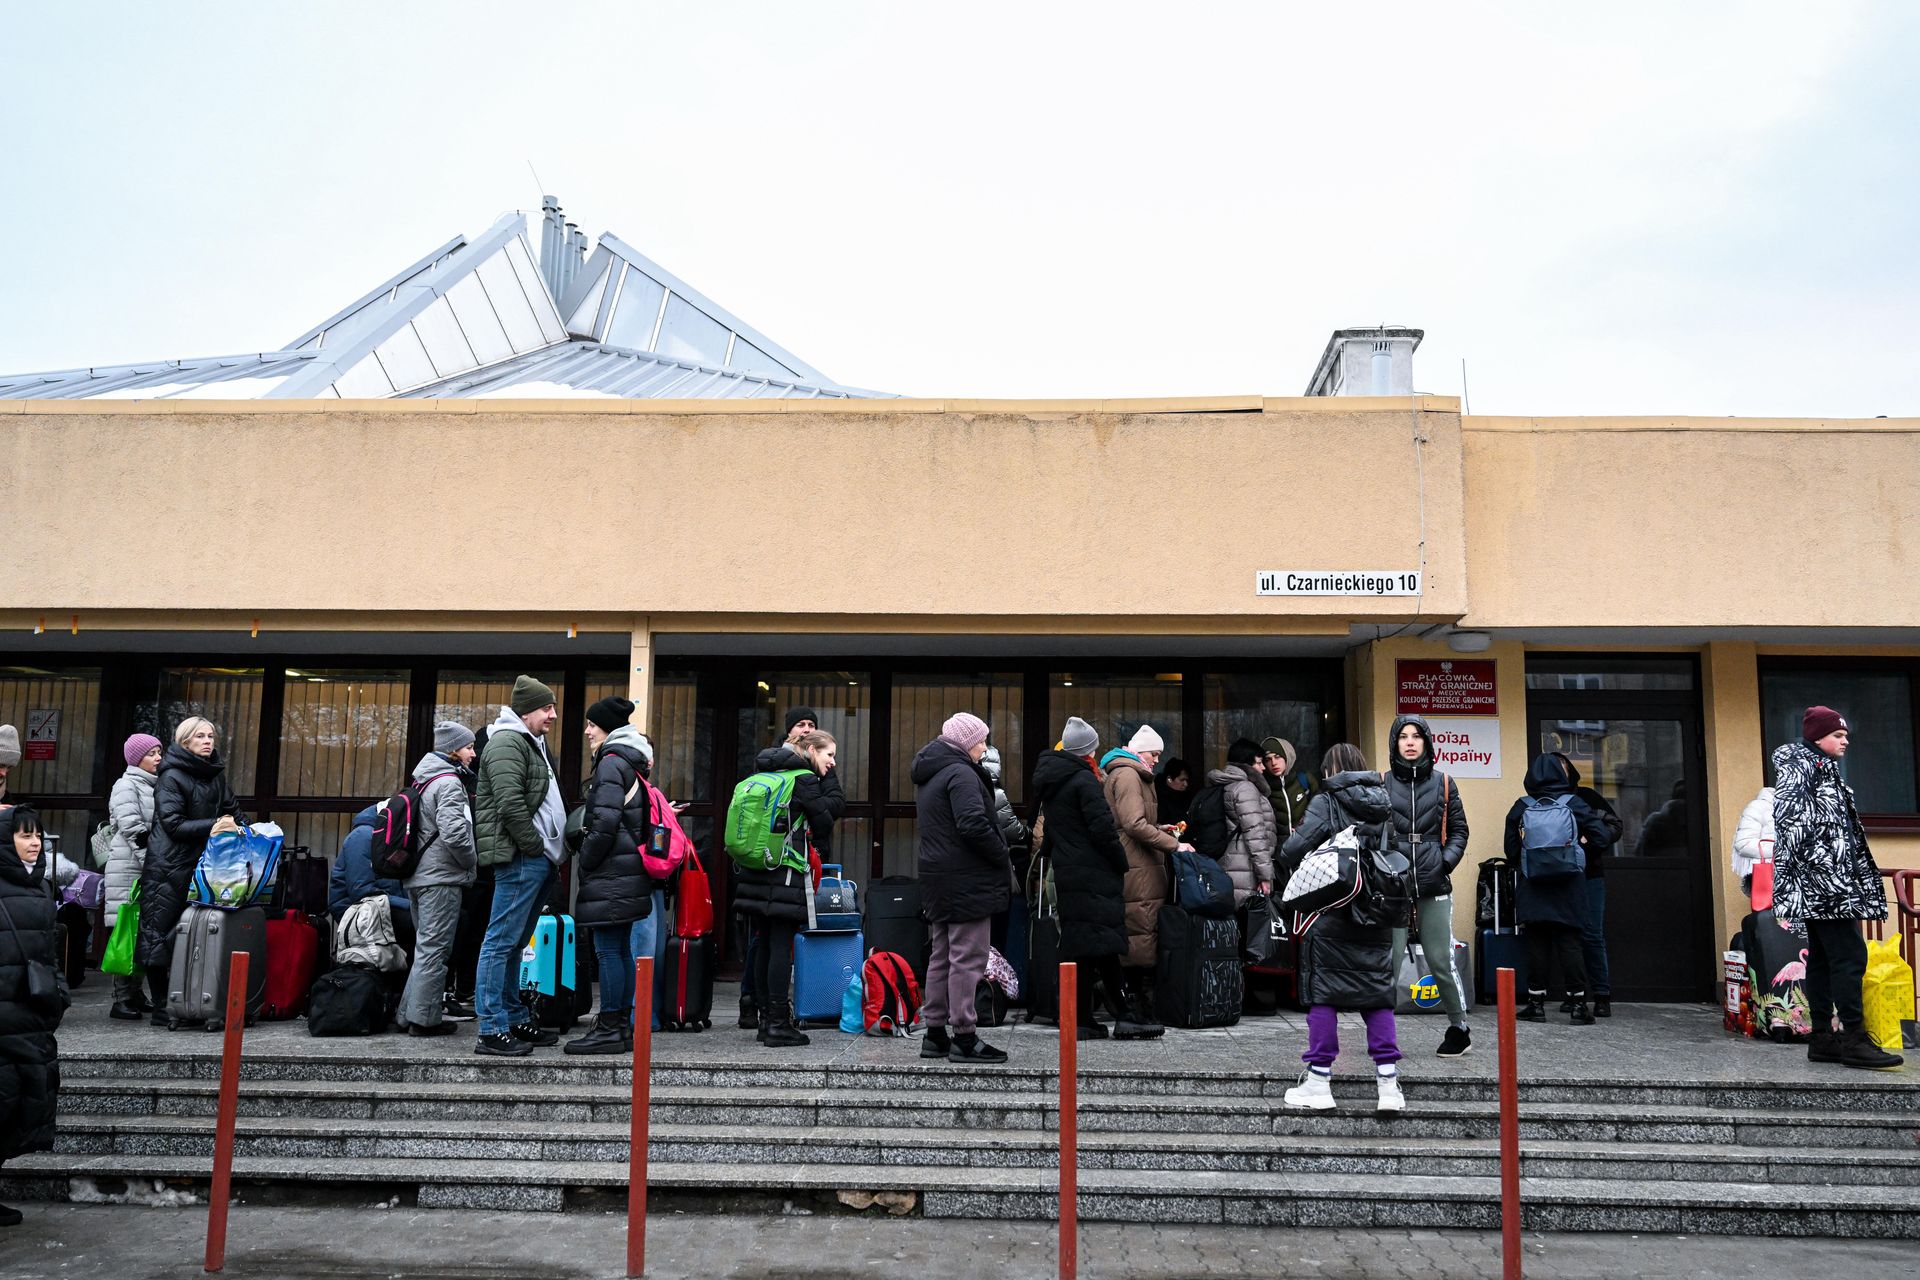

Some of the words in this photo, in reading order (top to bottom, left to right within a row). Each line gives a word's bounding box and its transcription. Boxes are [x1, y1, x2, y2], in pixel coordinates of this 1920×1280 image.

[1261, 574, 1281, 591] ul.
[1287, 574, 1394, 594] Czarnieckiego
[1399, 574, 1417, 591] 10
[1418, 673, 1476, 682] PLACÓWKA
[1440, 682, 1493, 690] GRANICZNEJ
[1400, 696, 1429, 704] KOLEJOWE
[1432, 696, 1460, 704] PRZEJŚCIE
[1463, 696, 1495, 704] GRANICZNE
